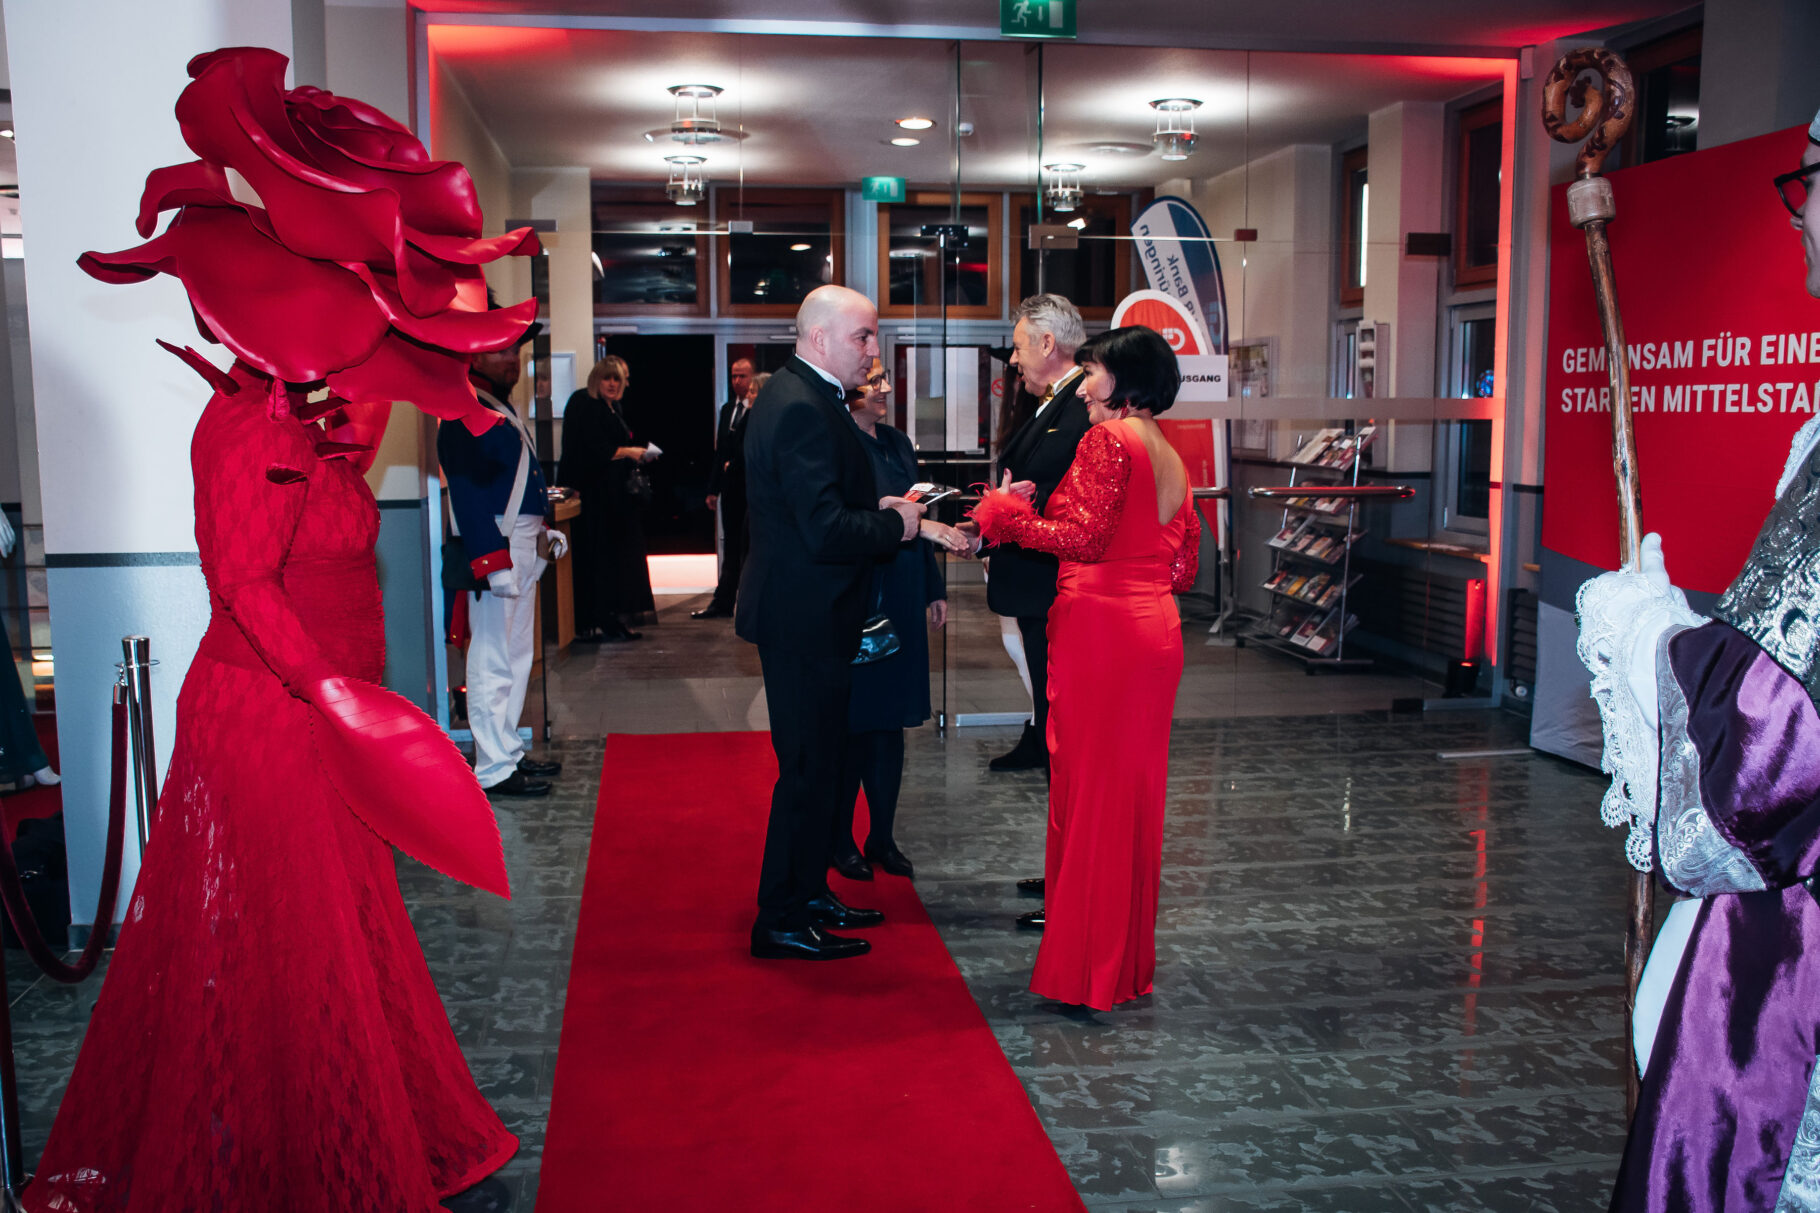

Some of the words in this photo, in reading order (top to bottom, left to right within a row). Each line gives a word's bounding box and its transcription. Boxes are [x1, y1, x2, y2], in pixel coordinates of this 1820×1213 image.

[1562, 340, 1694, 374] GEMNSAM
[1701, 331, 1752, 367] FÜR
[1760, 332, 1820, 365] EINE
[1181, 374, 1221, 383] USGANG
[1561, 386, 1655, 413] STAREN
